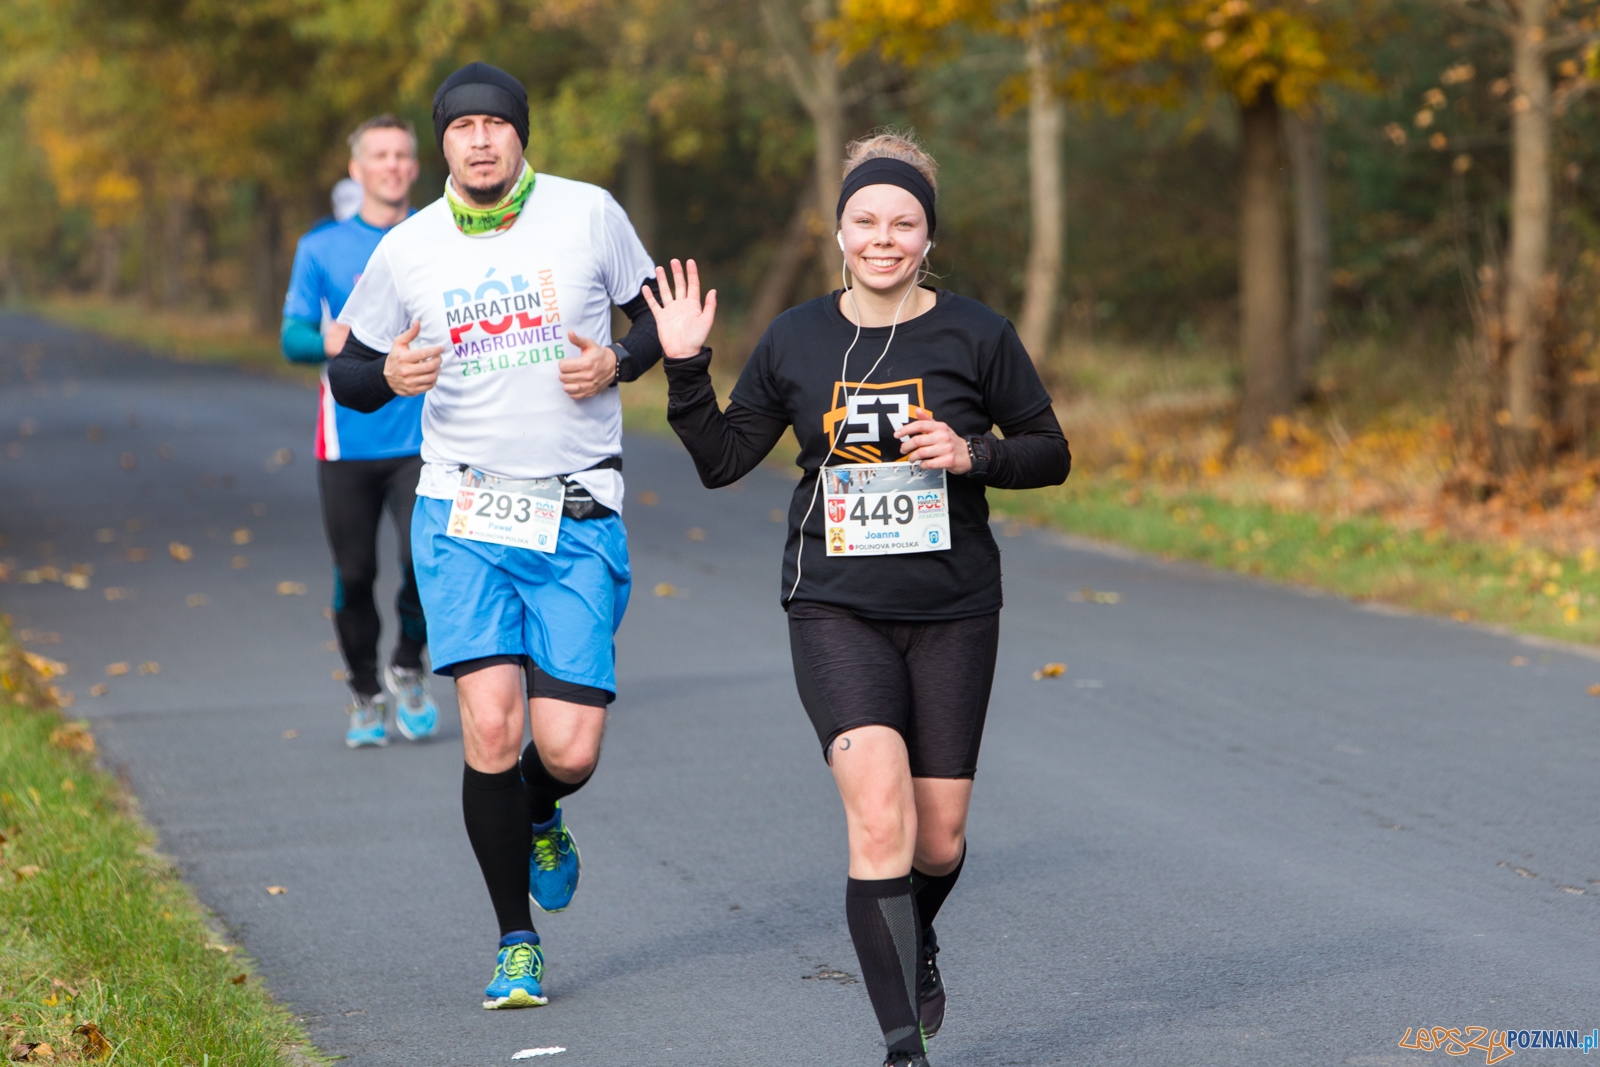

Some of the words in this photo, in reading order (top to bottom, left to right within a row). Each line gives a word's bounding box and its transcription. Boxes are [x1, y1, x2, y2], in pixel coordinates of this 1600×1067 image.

[446, 292, 541, 327] MARATON
[538, 269, 560, 323] SKOKI
[453, 325, 562, 358] WĄGROWIEC
[461, 344, 565, 377] 23.10.2016
[475, 492, 531, 523] 293
[849, 494, 914, 526] 449
[475, 531, 504, 540] POLINOVA
[505, 536, 529, 544] POLSKA
[855, 542, 890, 551] POLINOVA
[891, 541, 919, 549] POLSKA
[865, 531, 900, 540] Joanna
